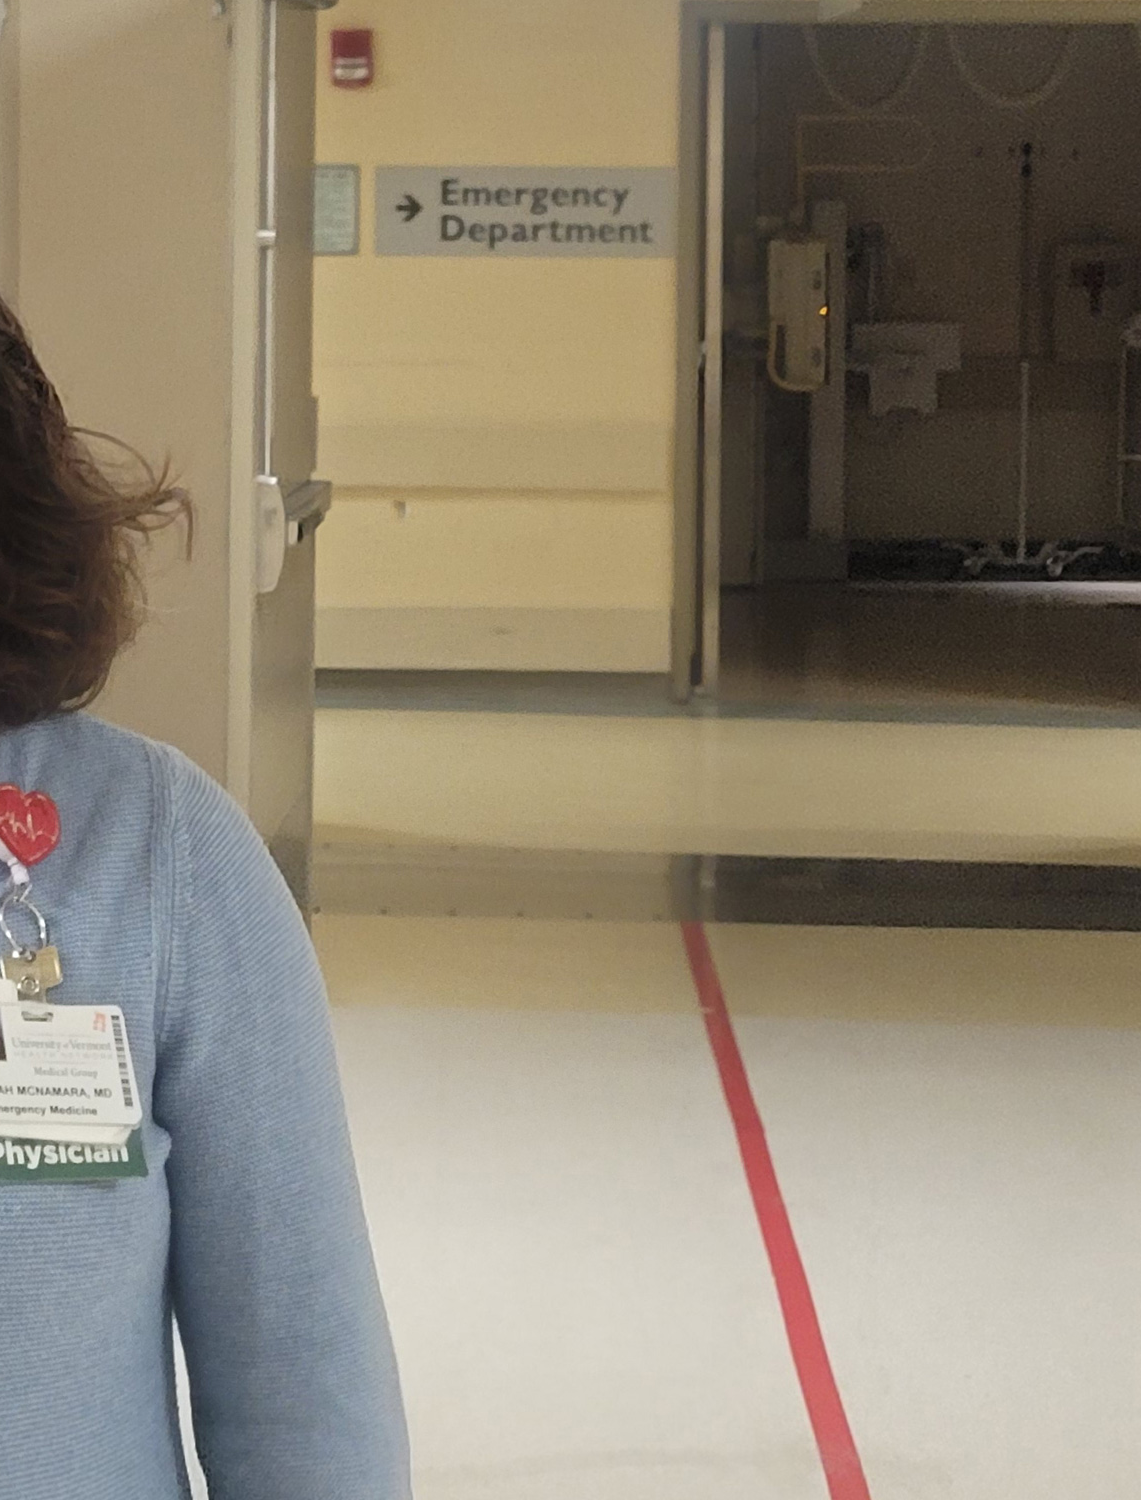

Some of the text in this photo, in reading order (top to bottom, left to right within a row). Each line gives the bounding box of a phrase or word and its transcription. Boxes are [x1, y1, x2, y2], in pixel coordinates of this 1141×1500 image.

[440, 178, 630, 216] Emergency
[440, 214, 653, 250] Department
[11, 1037, 61, 1052] University
[69, 1038, 111, 1051] Vermont
[34, 1066, 98, 1079] Medical Group
[94, 1088, 112, 1098] MD
[50, 1105, 98, 1116] Medicine
